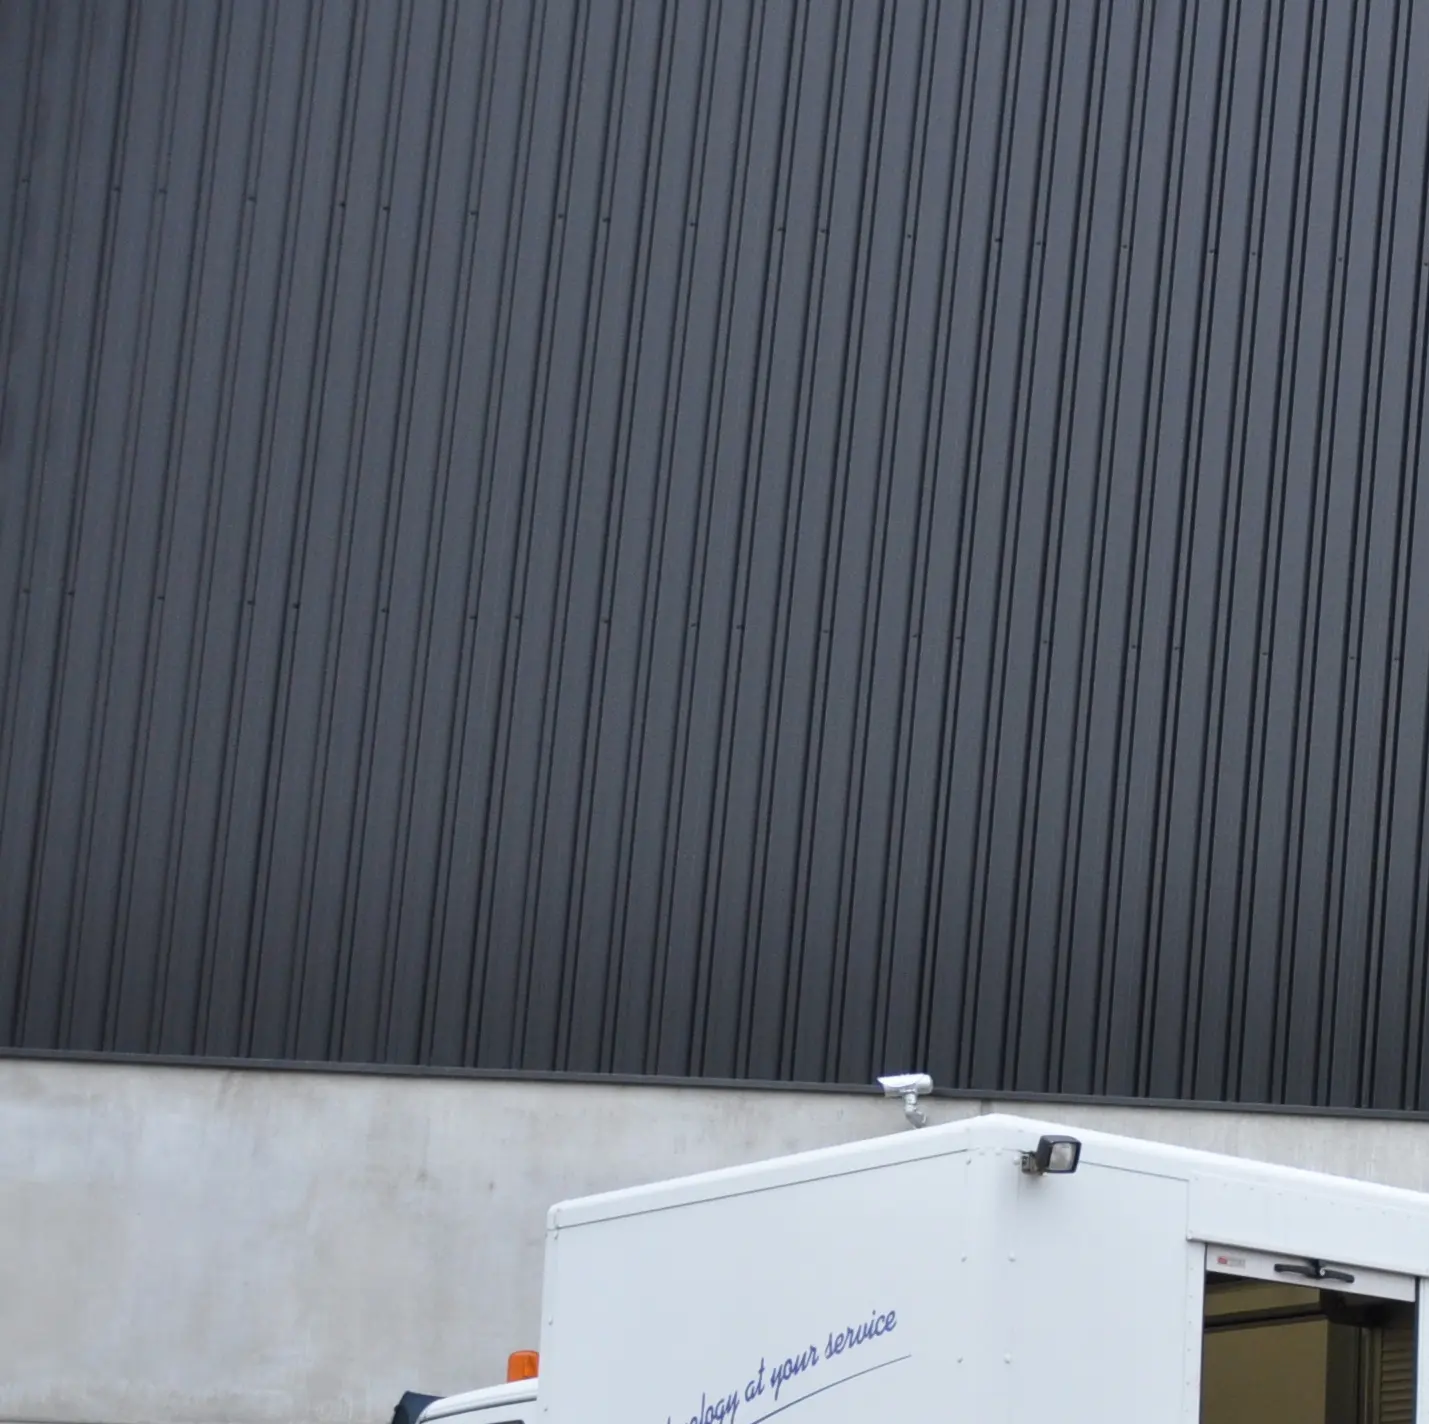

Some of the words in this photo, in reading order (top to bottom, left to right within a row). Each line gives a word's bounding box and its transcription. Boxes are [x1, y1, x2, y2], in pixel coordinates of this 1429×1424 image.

[744, 1357, 765, 1402] at
[770, 1344, 820, 1401] your
[825, 1310, 898, 1360] service
